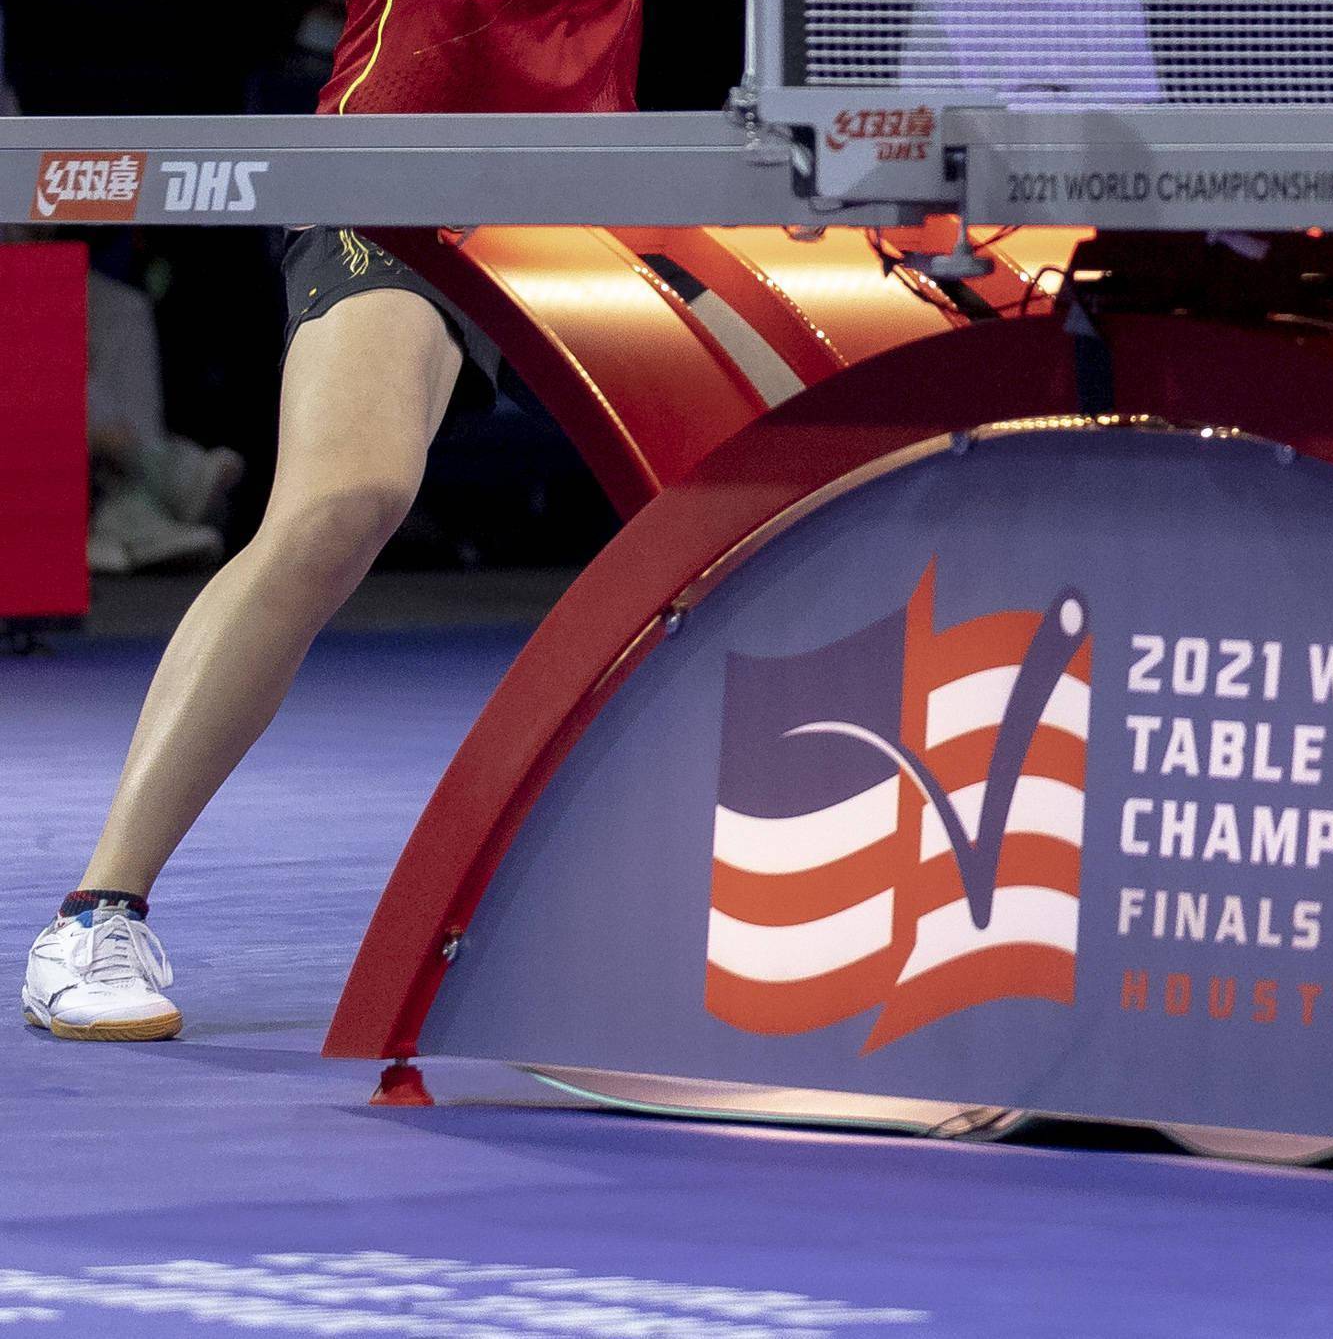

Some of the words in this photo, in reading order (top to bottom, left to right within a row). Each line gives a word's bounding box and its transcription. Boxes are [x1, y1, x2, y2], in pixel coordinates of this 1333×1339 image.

[37, 156, 141, 217] 红双喜
[160, 161, 269, 212] DHS
[1007, 172, 1057, 203] 2021
[1063, 171, 1149, 202] WORLD
[1126, 633, 1282, 701] 2021
[1125, 714, 1327, 786] TABLE
[1116, 888, 1324, 951] FINALS
